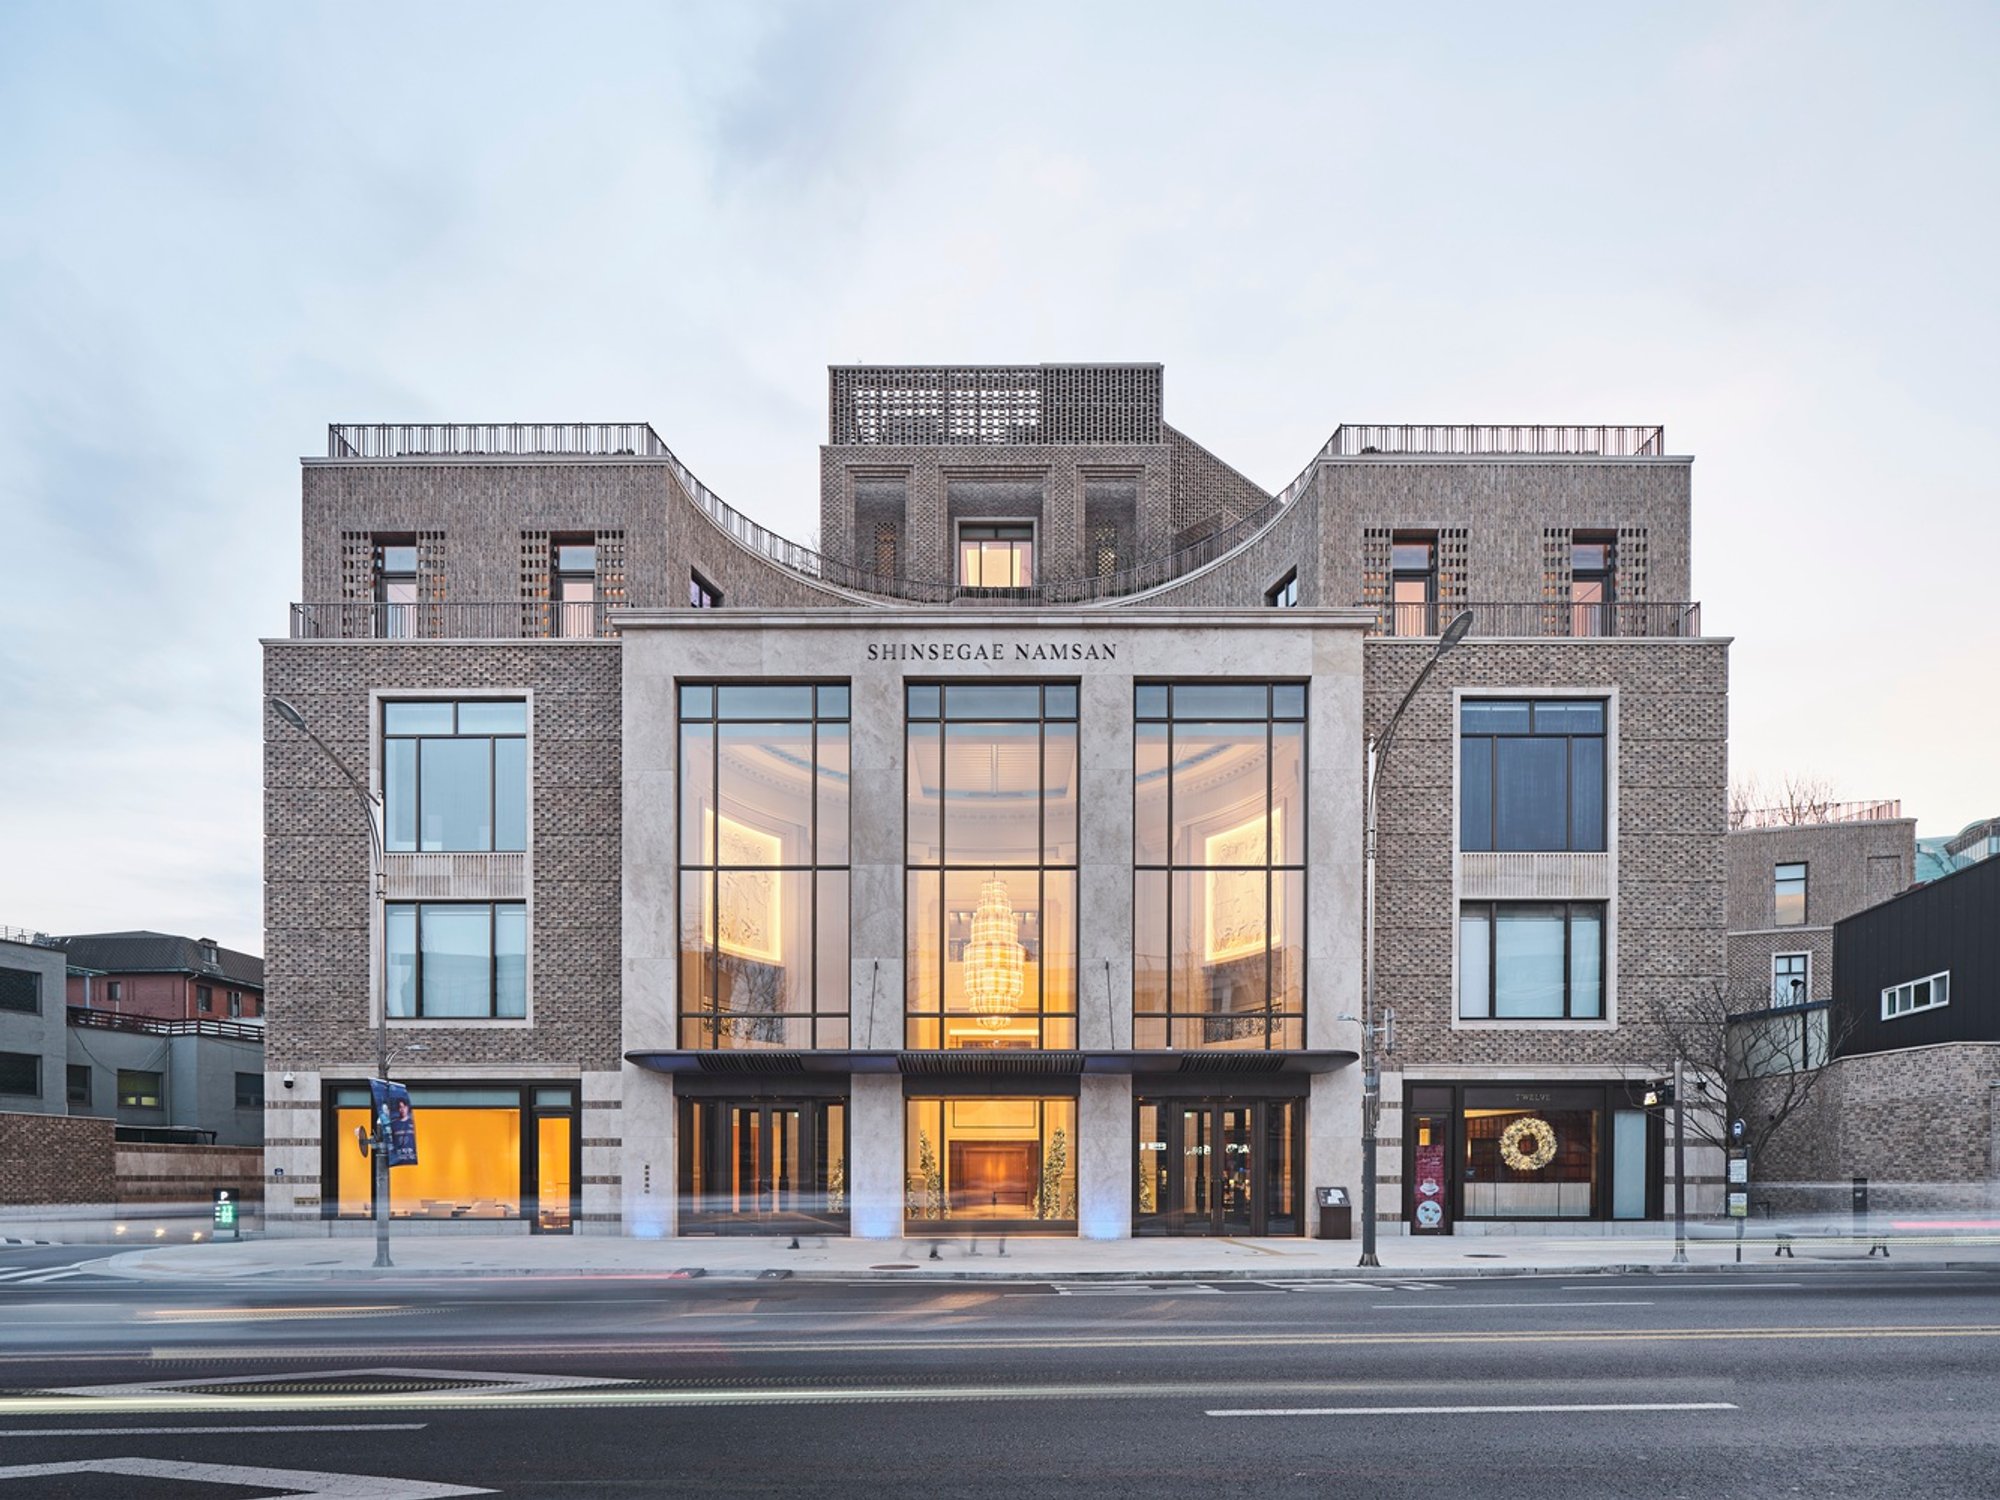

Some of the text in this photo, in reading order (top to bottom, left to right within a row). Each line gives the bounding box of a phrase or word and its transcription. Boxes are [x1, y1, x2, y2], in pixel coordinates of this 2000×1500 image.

[868, 643, 1117, 660] SHINSEGAE NAMSAN
[1515, 1093, 1551, 1102] TWELVE
[220, 1191, 229, 1200] P
